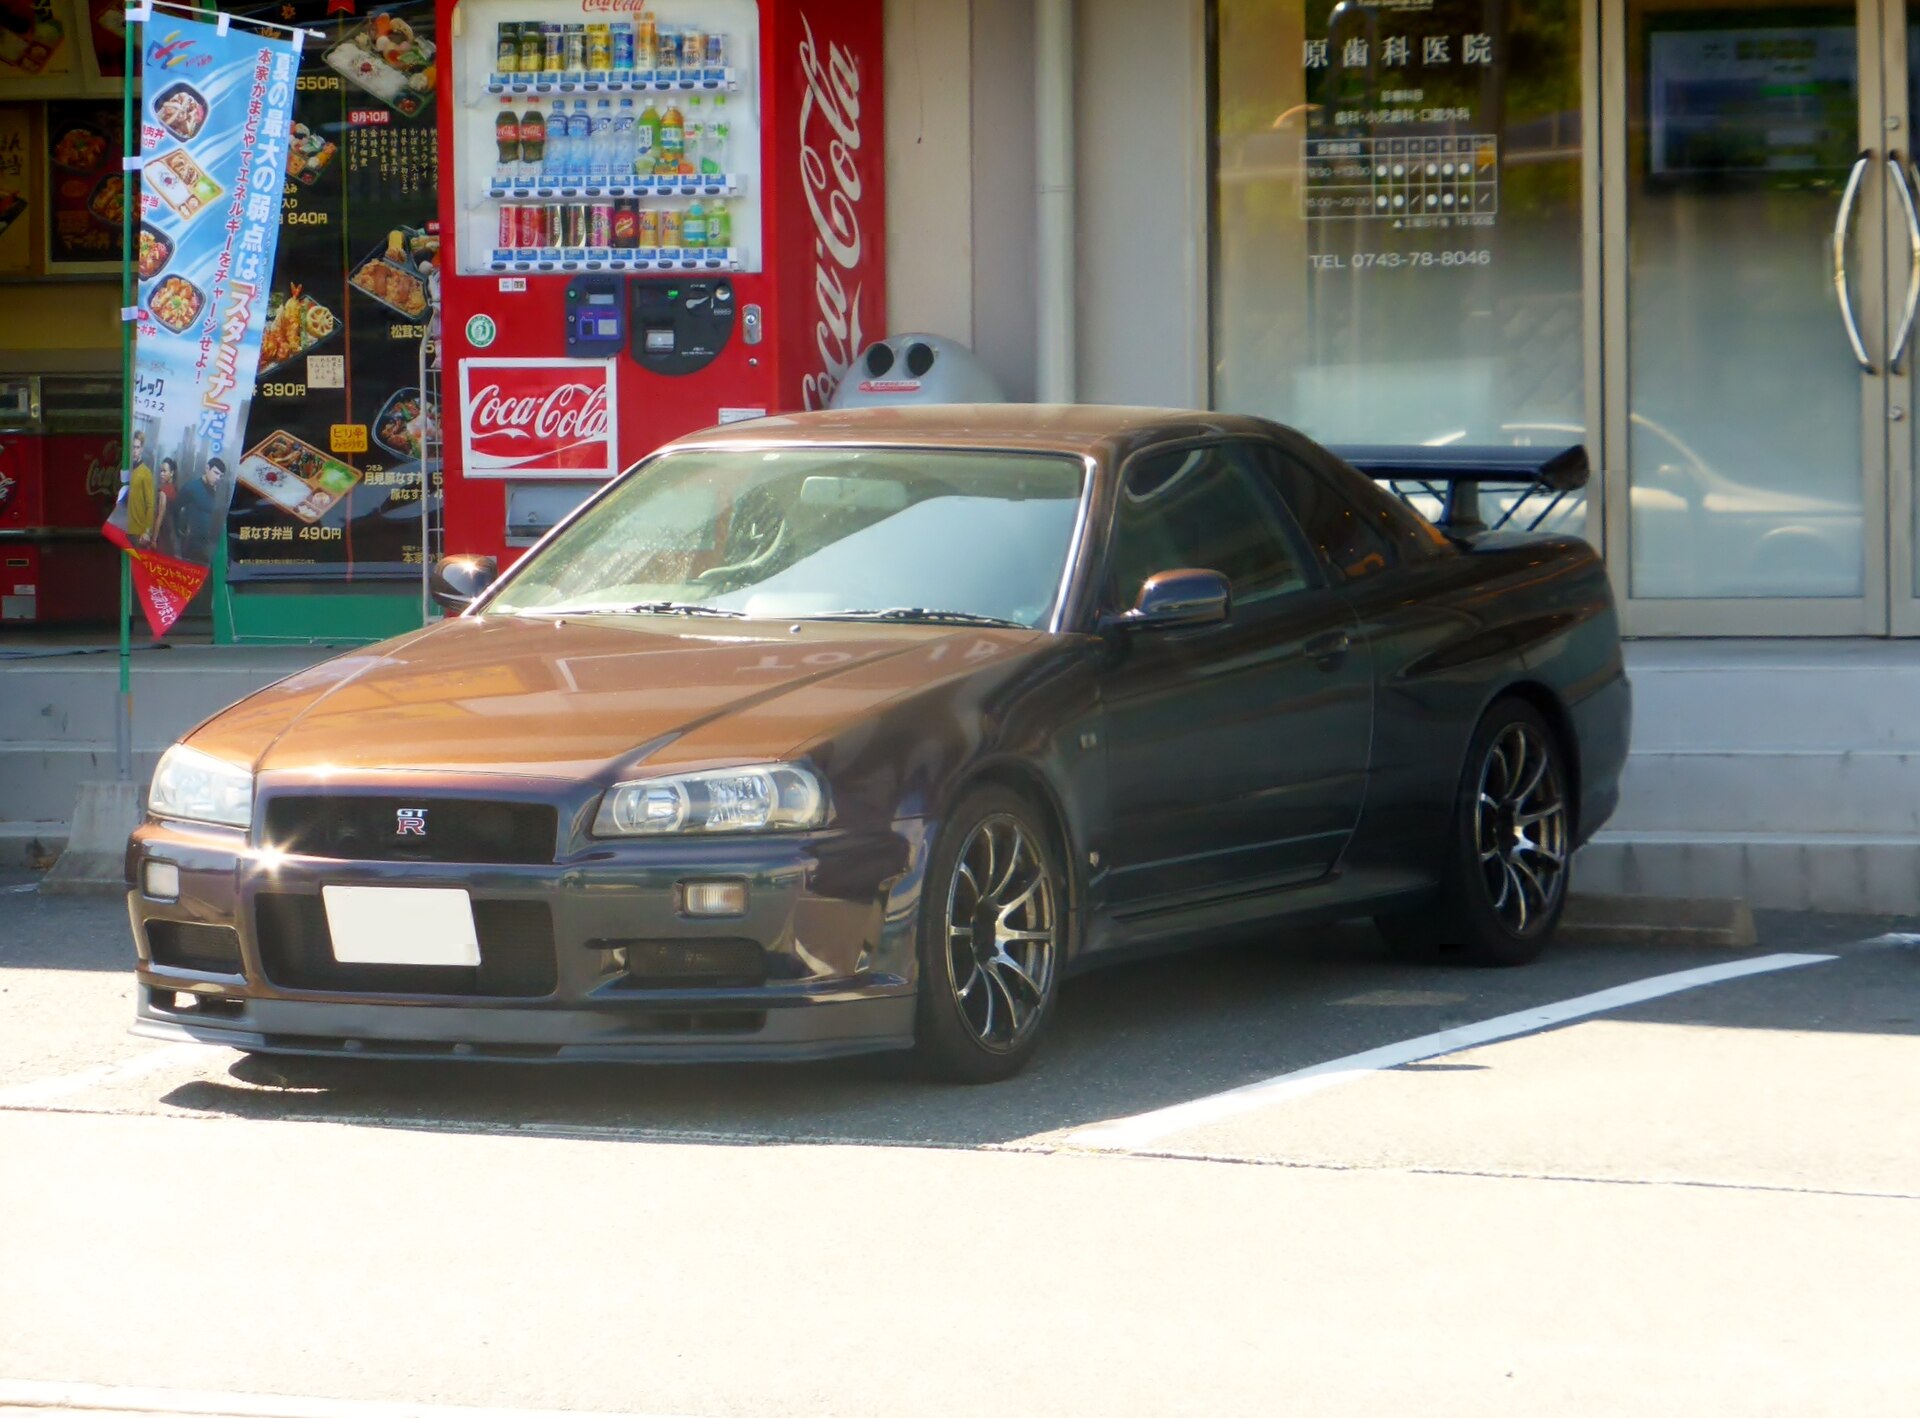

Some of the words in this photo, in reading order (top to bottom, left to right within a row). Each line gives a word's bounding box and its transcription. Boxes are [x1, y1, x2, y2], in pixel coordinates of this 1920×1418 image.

[1301, 32, 1493, 68] 原歯科医院
[287, 212, 328, 225] 840円
[1309, 253, 1346, 269] TEL
[1351, 250, 1491, 269] 0743-78-8046
[263, 383, 306, 397] 390円
[239, 526, 293, 540] 豚なす弁当
[299, 526, 342, 540] 490円
[396, 808, 429, 817] GT
[396, 816, 426, 836] R
